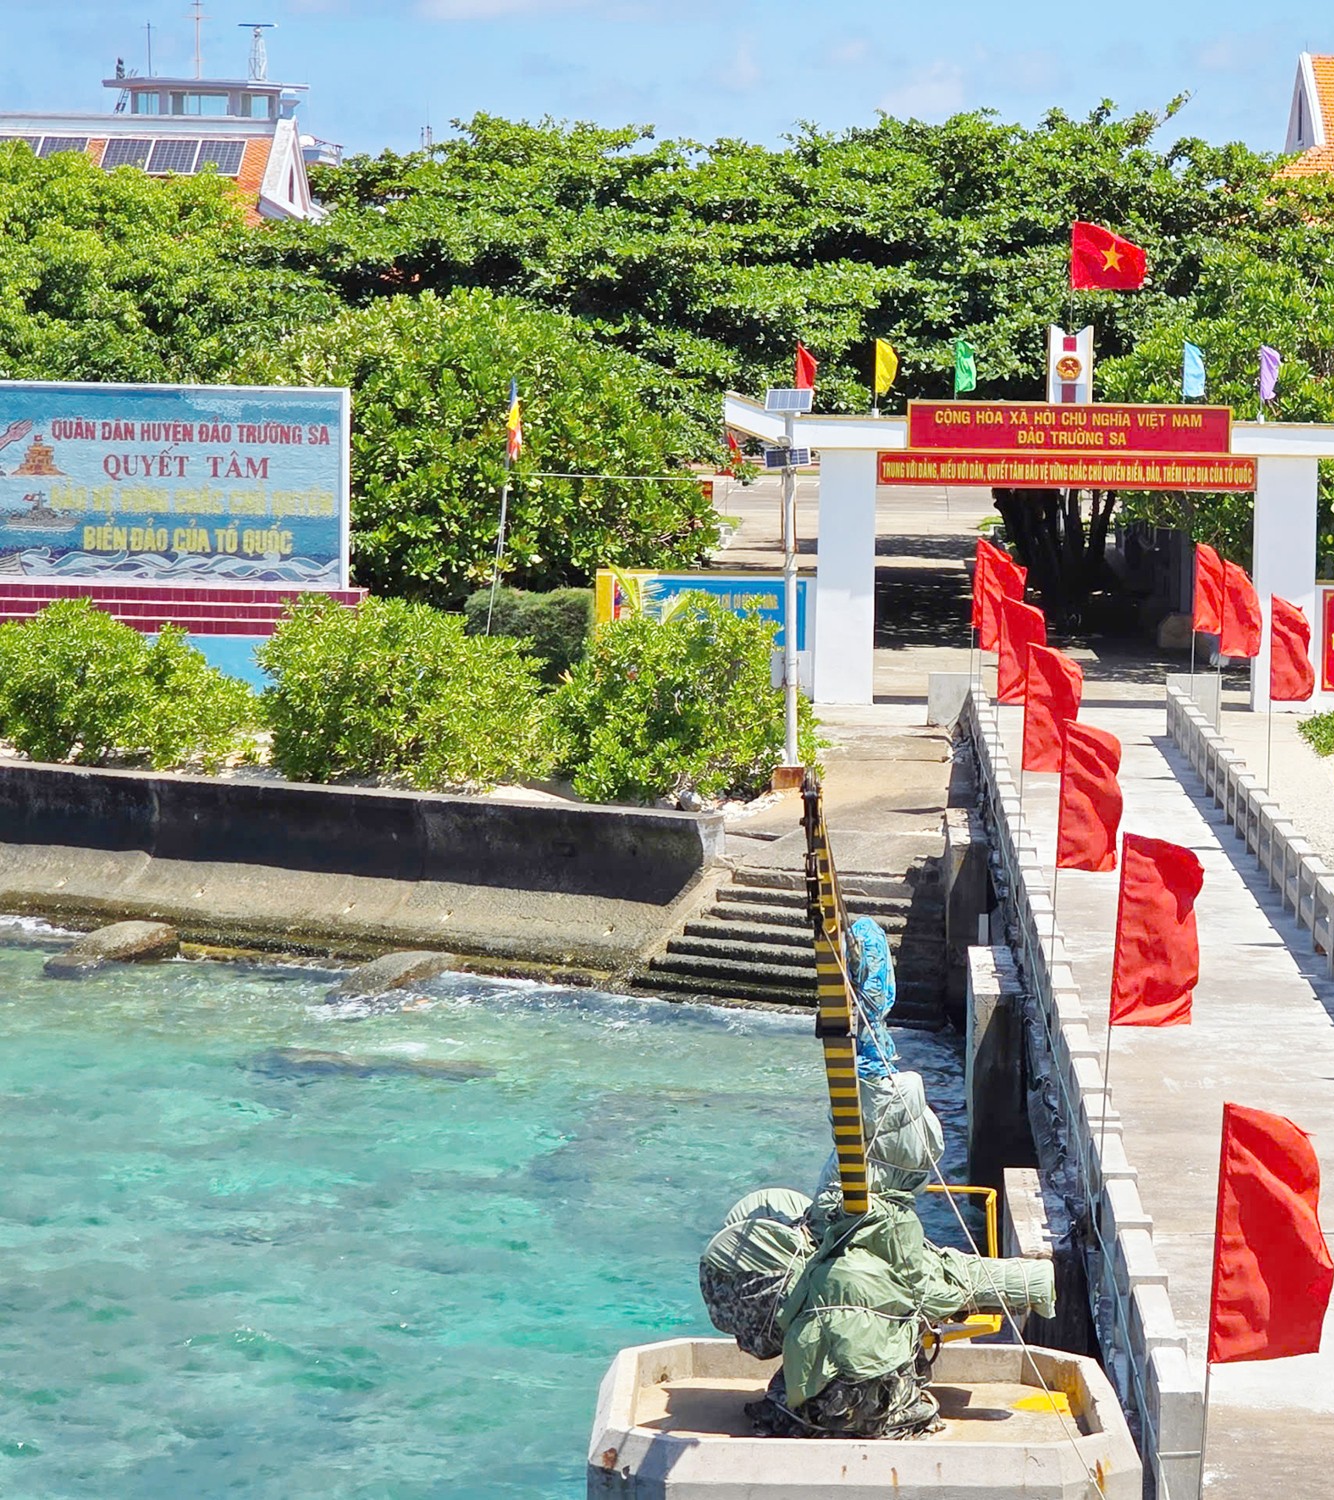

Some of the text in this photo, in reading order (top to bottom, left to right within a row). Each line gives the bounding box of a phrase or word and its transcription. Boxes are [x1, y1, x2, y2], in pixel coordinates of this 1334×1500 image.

[52, 417, 96, 441] QUÂN
[101, 418, 135, 441] DÂN
[141, 420, 194, 446] HUYỆN
[198, 415, 232, 443] ĐẢO
[308, 425, 330, 446] SA
[935, 408, 1203, 430] CỘNG HÒA XÃ HỘI CHỦ NGHĨA VIỆT NAM
[1017, 427, 1127, 446] ĐẢO TRƯỜNG SA
[103, 446, 271, 480] QUYẾT TÂM
[882, 461, 905, 479] TRUNG
[906, 459, 918, 479] VỚI
[940, 458, 957, 479] HIẾU
[957, 460, 969, 480] VỚI
[970, 460, 986, 482] DÂN,
[987, 459, 1009, 481] QUYẾT
[1009, 461, 1024, 480] TÂM
[1025, 459, 1039, 480] BẢO
[1040, 461, 1049, 484] VỆ
[1088, 460, 1103, 481] CHỦ
[1146, 461, 1162, 484] ĐẢO,
[1182, 467, 1196, 486] LỤC
[1209, 462, 1223, 483] CỦA
[1233, 463, 1253, 485] QUỐC
[83, 517, 128, 550] BIỂN
[130, 518, 169, 551] ĐẢO
[173, 519, 212, 553] CỦA
[214, 520, 239, 554] TỔ
